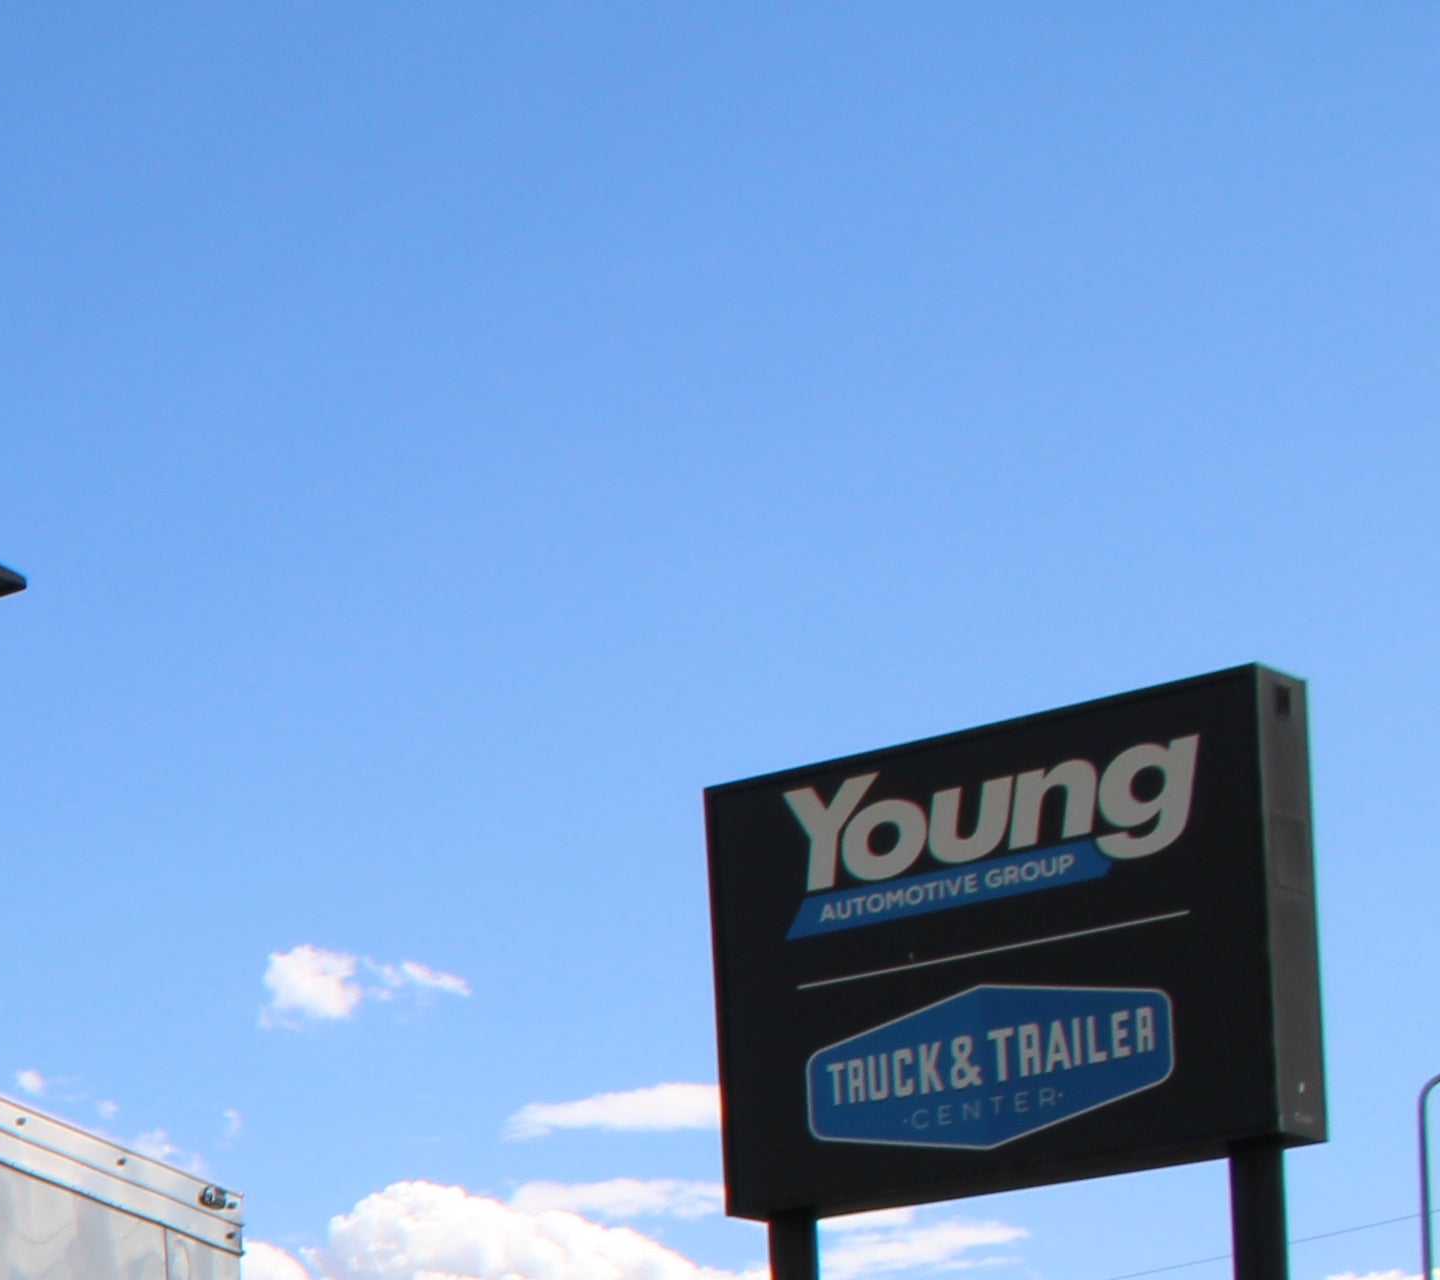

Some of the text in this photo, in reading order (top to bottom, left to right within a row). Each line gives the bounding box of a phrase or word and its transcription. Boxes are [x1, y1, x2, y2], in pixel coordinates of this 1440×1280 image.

[782, 733, 1200, 892] Young
[819, 853, 1075, 923] AUTOMOTIVE GROUP
[826, 1040, 944, 1106] TRUCK
[987, 1006, 1156, 1077] TRAILER
[910, 1087, 1057, 1131] CENTER
